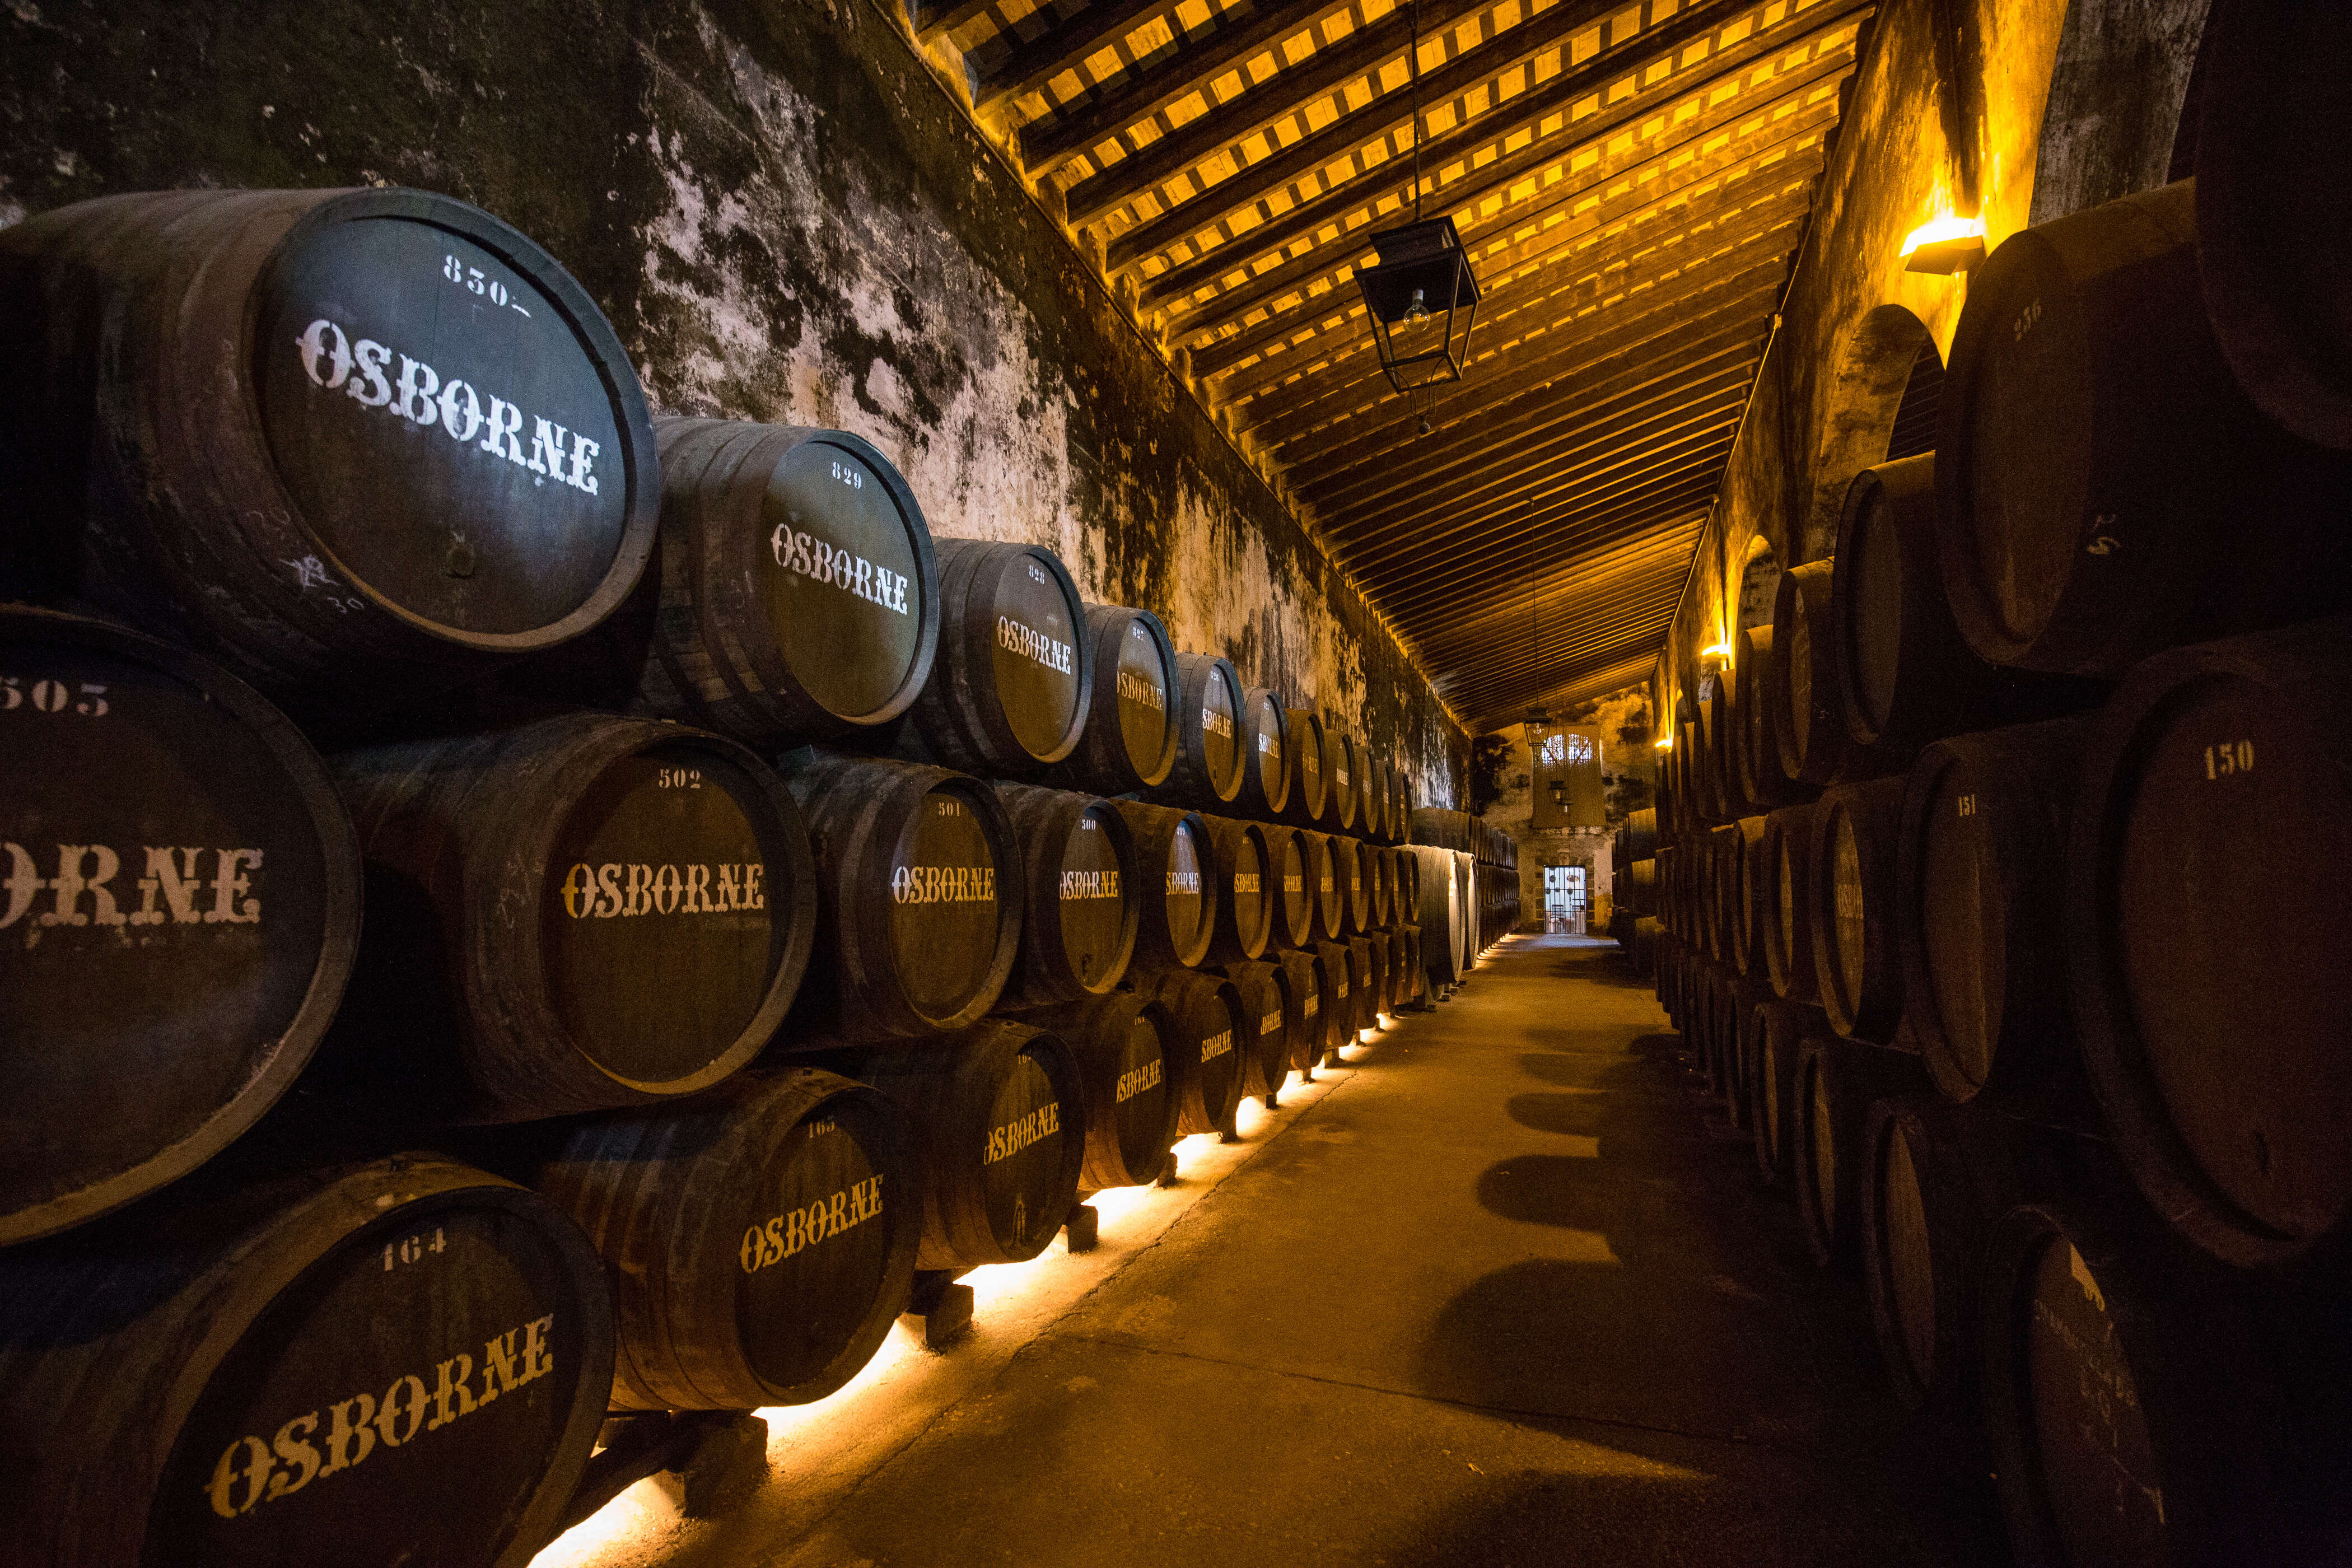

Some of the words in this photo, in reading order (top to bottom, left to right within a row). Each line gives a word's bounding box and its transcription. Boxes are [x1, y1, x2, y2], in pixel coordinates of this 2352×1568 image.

[295, 319, 600, 496] OSBORNE
[832, 461, 862, 489] 829
[771, 522, 908, 615] OSBORNE
[1029, 564, 1045, 585] 828
[996, 615, 1071, 675] OSBORNE
[658, 768, 701, 789] 502
[2204, 740, 2255, 780] 150
[938, 801, 960, 817] 501
[1081, 819, 1096, 831] 500
[1958, 794, 1976, 816] 151
[560, 863, 764, 919] OSBORNE
[892, 866, 995, 904] OSBORNE
[1234, 873, 1259, 893] SBORNE
[983, 1102, 1059, 1165] OSBORNE
[739, 1174, 885, 1275] OSBORNE
[381, 1228, 447, 1272] 164
[204, 1313, 554, 1519] OSBORNE
